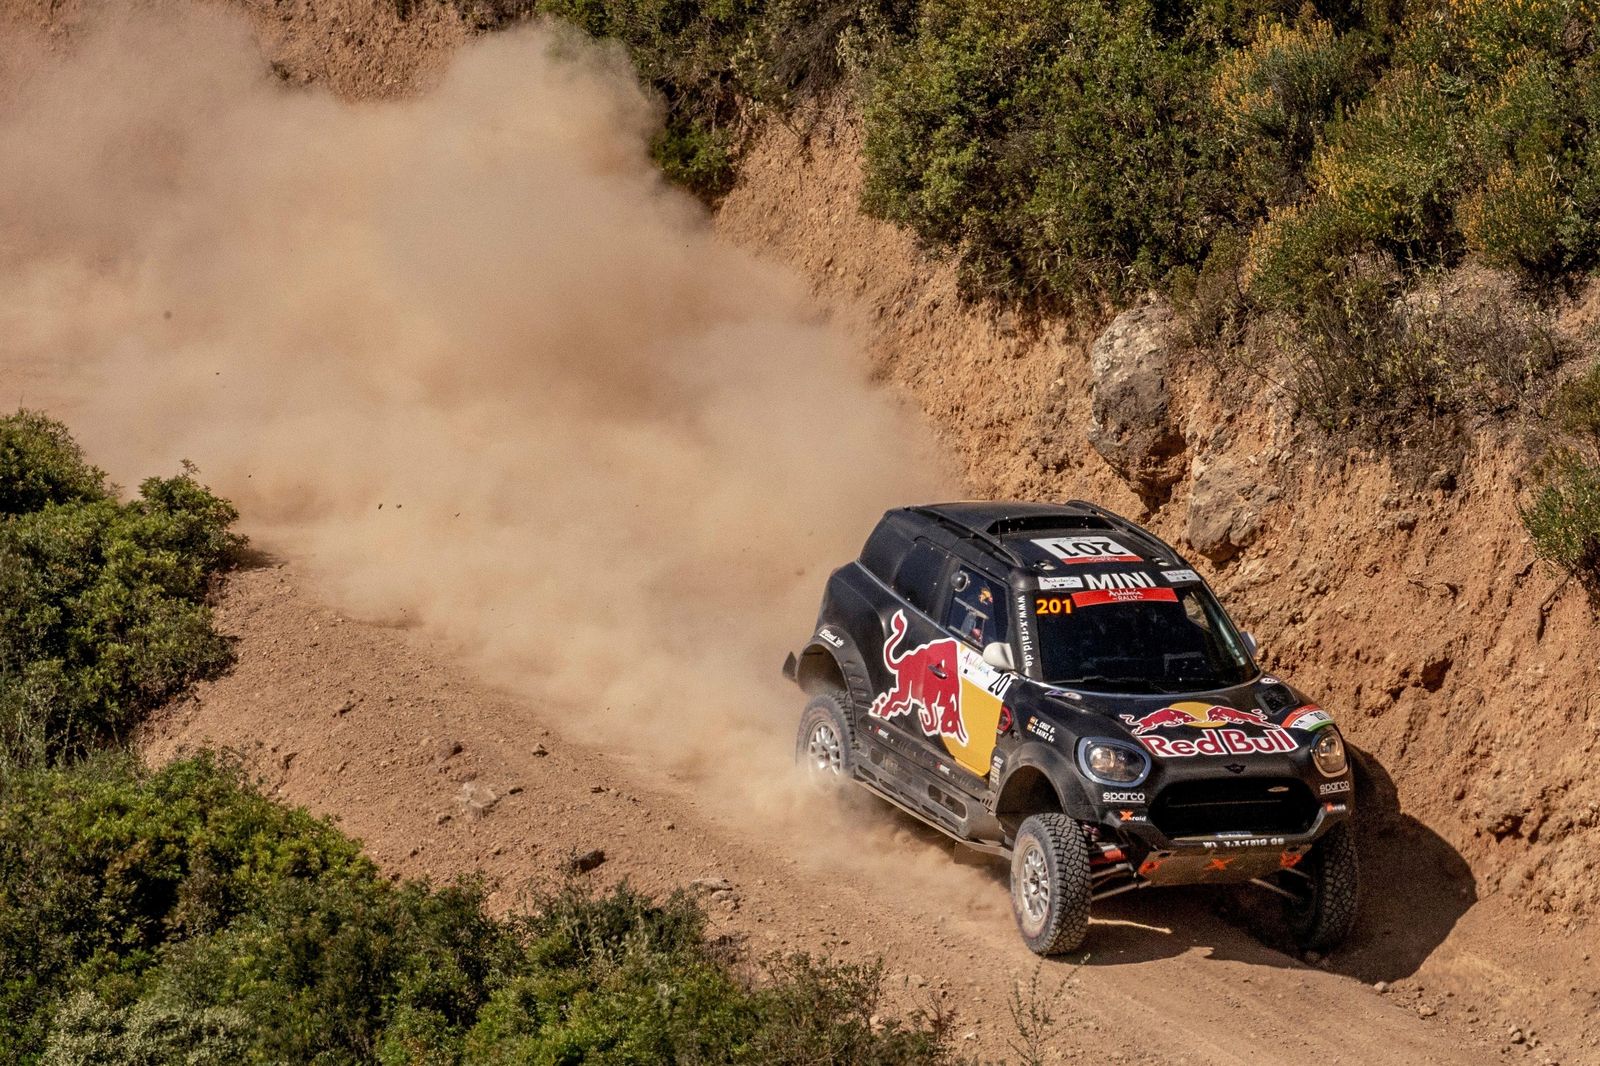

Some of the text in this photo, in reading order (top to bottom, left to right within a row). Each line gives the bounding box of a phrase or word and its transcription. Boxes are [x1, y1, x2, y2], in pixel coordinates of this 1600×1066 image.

[1052, 542, 1126, 557] 201
[1084, 572, 1157, 590] MINI
[1036, 598, 1072, 614] 201
[1018, 595, 1034, 667] www.x-raid.de
[1140, 728, 1298, 757] Red Bull
[1320, 781, 1350, 794] sparco
[1103, 792, 1145, 803] sparco
